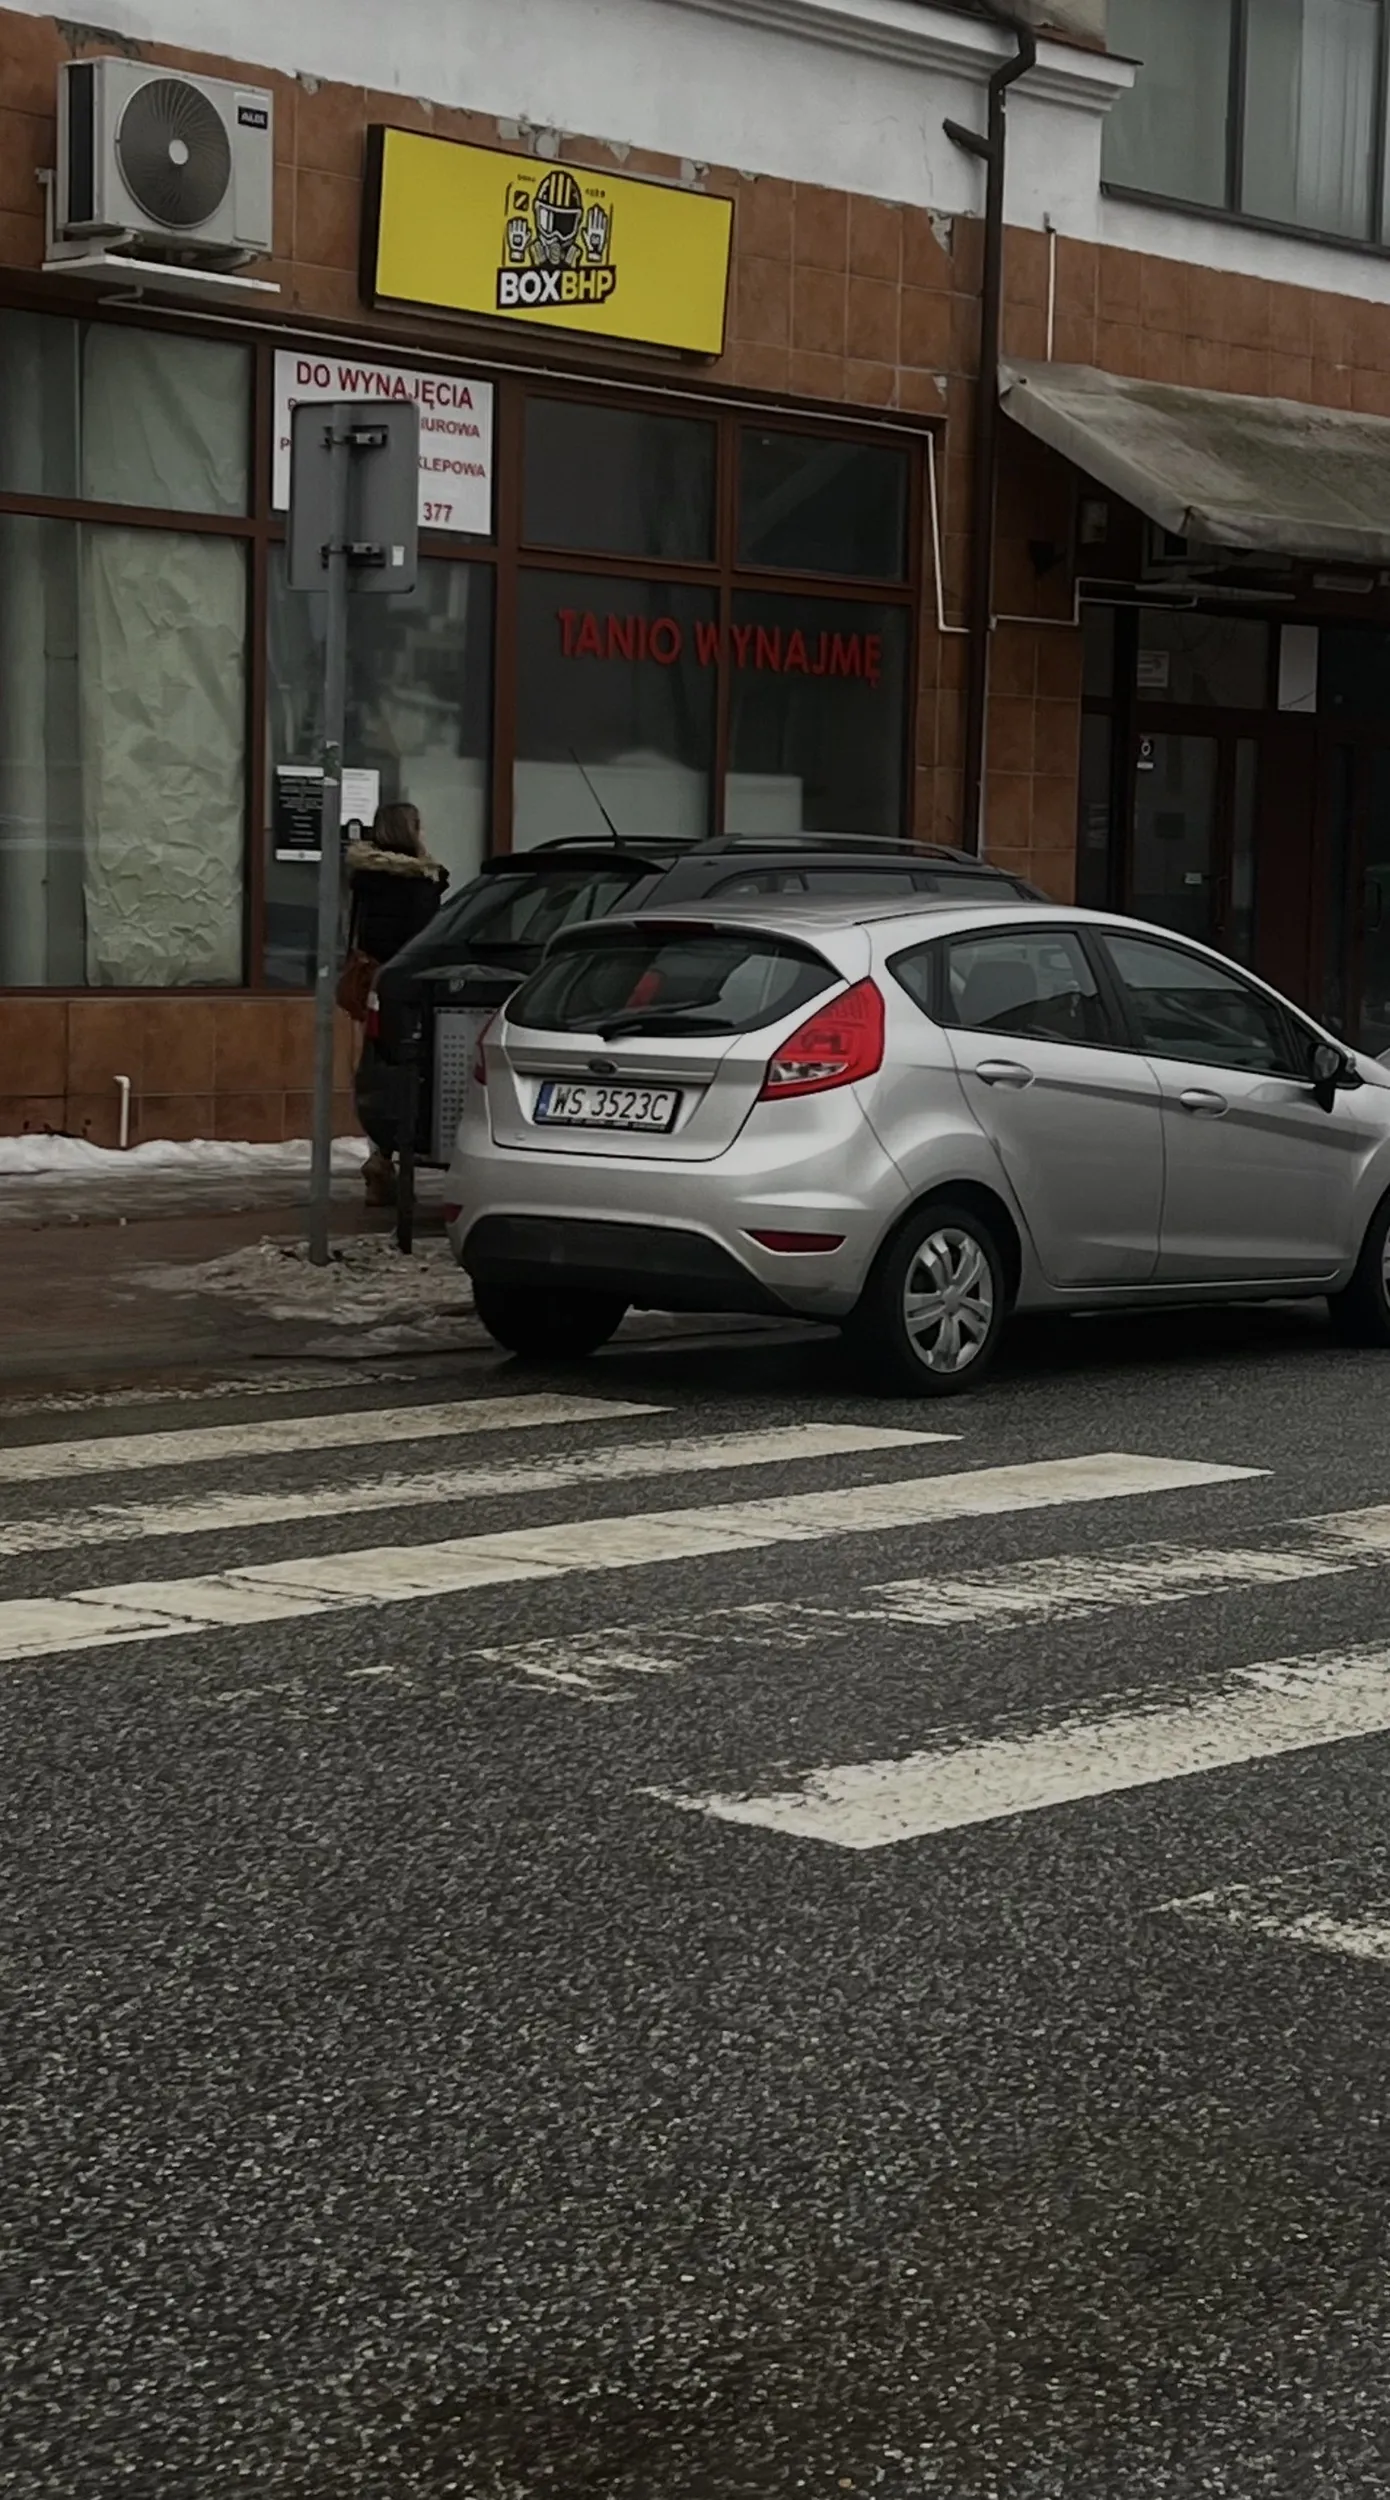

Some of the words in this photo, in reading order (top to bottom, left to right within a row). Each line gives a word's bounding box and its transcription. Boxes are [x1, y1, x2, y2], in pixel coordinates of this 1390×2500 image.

[500, 269, 613, 304] BOXBHP
[296, 361, 331, 388] DO
[338, 366, 474, 410] WYNAJĘCIA
[420, 416, 481, 438] IUROWA
[423, 502, 453, 524] 377
[556, 608, 682, 664] TANIO
[695, 620, 882, 688] WYNAJMĘ
[553, 1086, 587, 1115] WS
[591, 1089, 669, 1121] 3523C
